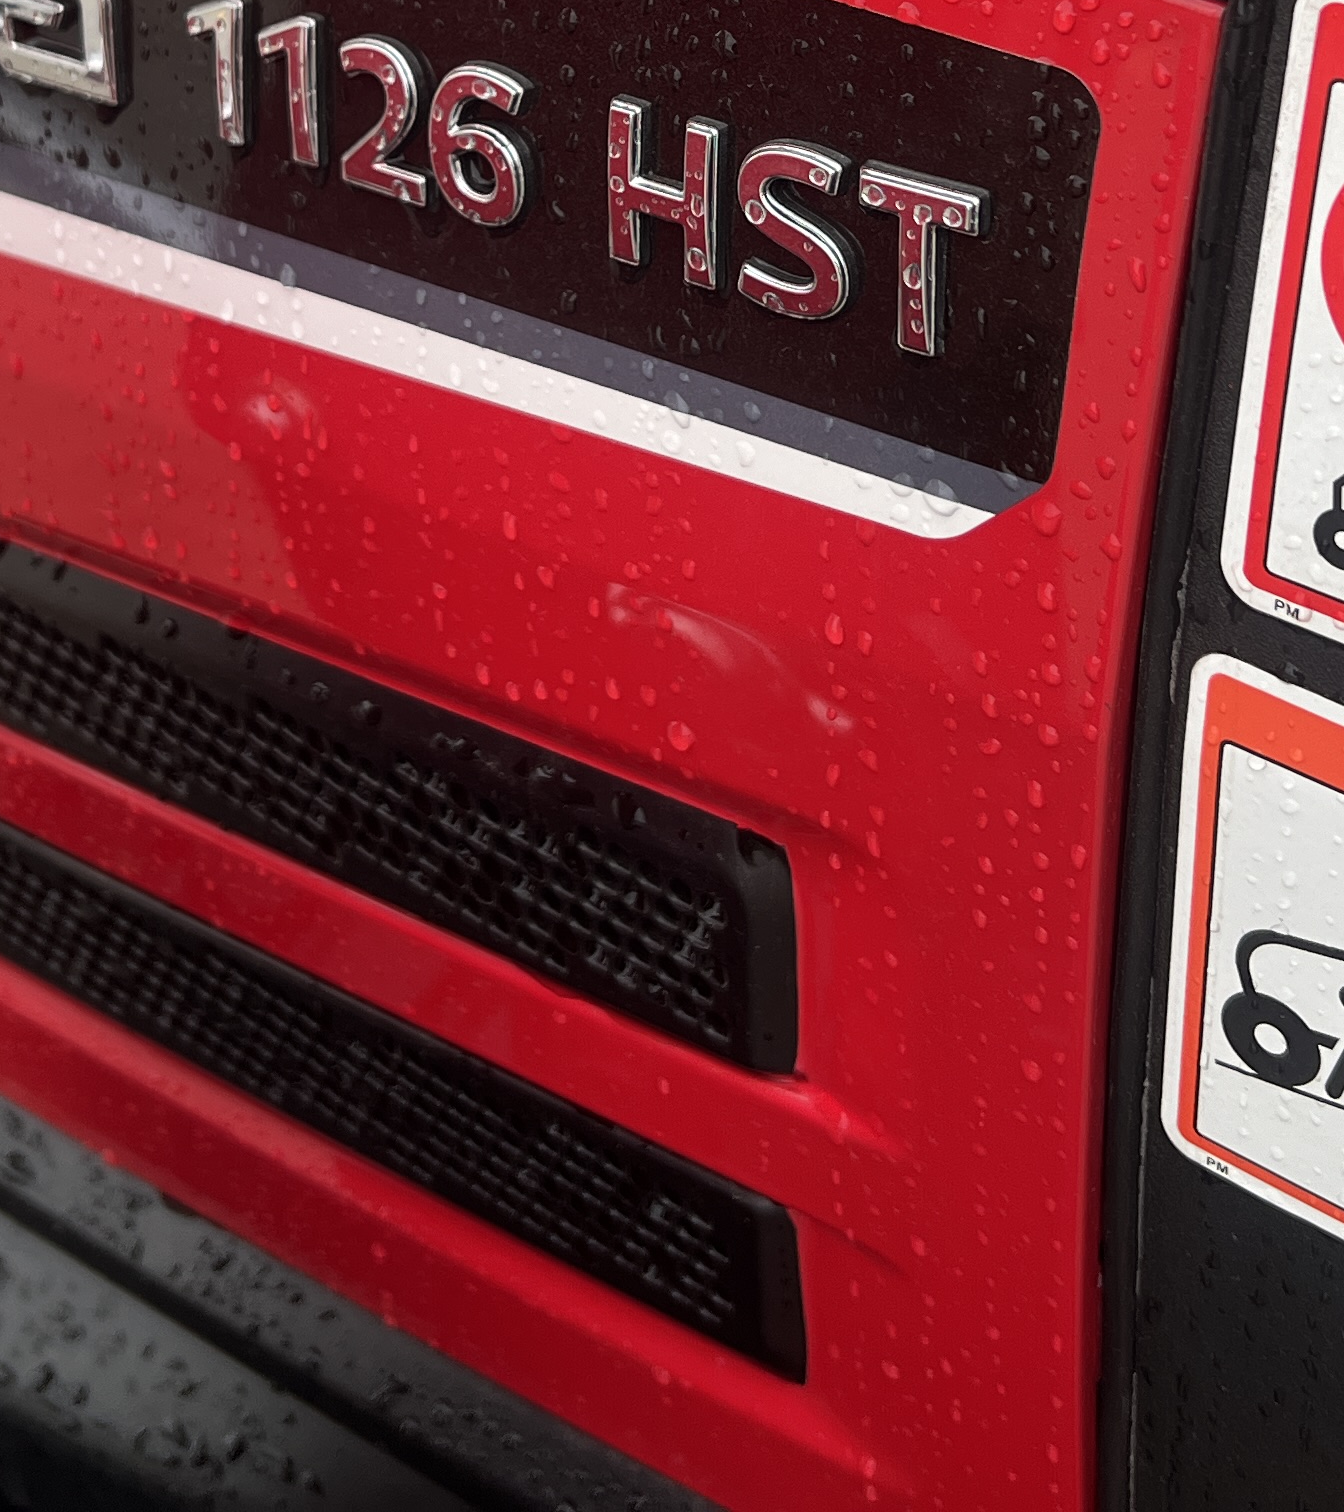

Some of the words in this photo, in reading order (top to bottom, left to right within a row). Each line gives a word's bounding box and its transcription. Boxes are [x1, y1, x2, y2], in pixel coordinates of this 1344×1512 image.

[607, 94, 992, 357] HST
[1274, 598, 1299, 620] PM
[1206, 1156, 1228, 1175] PM
